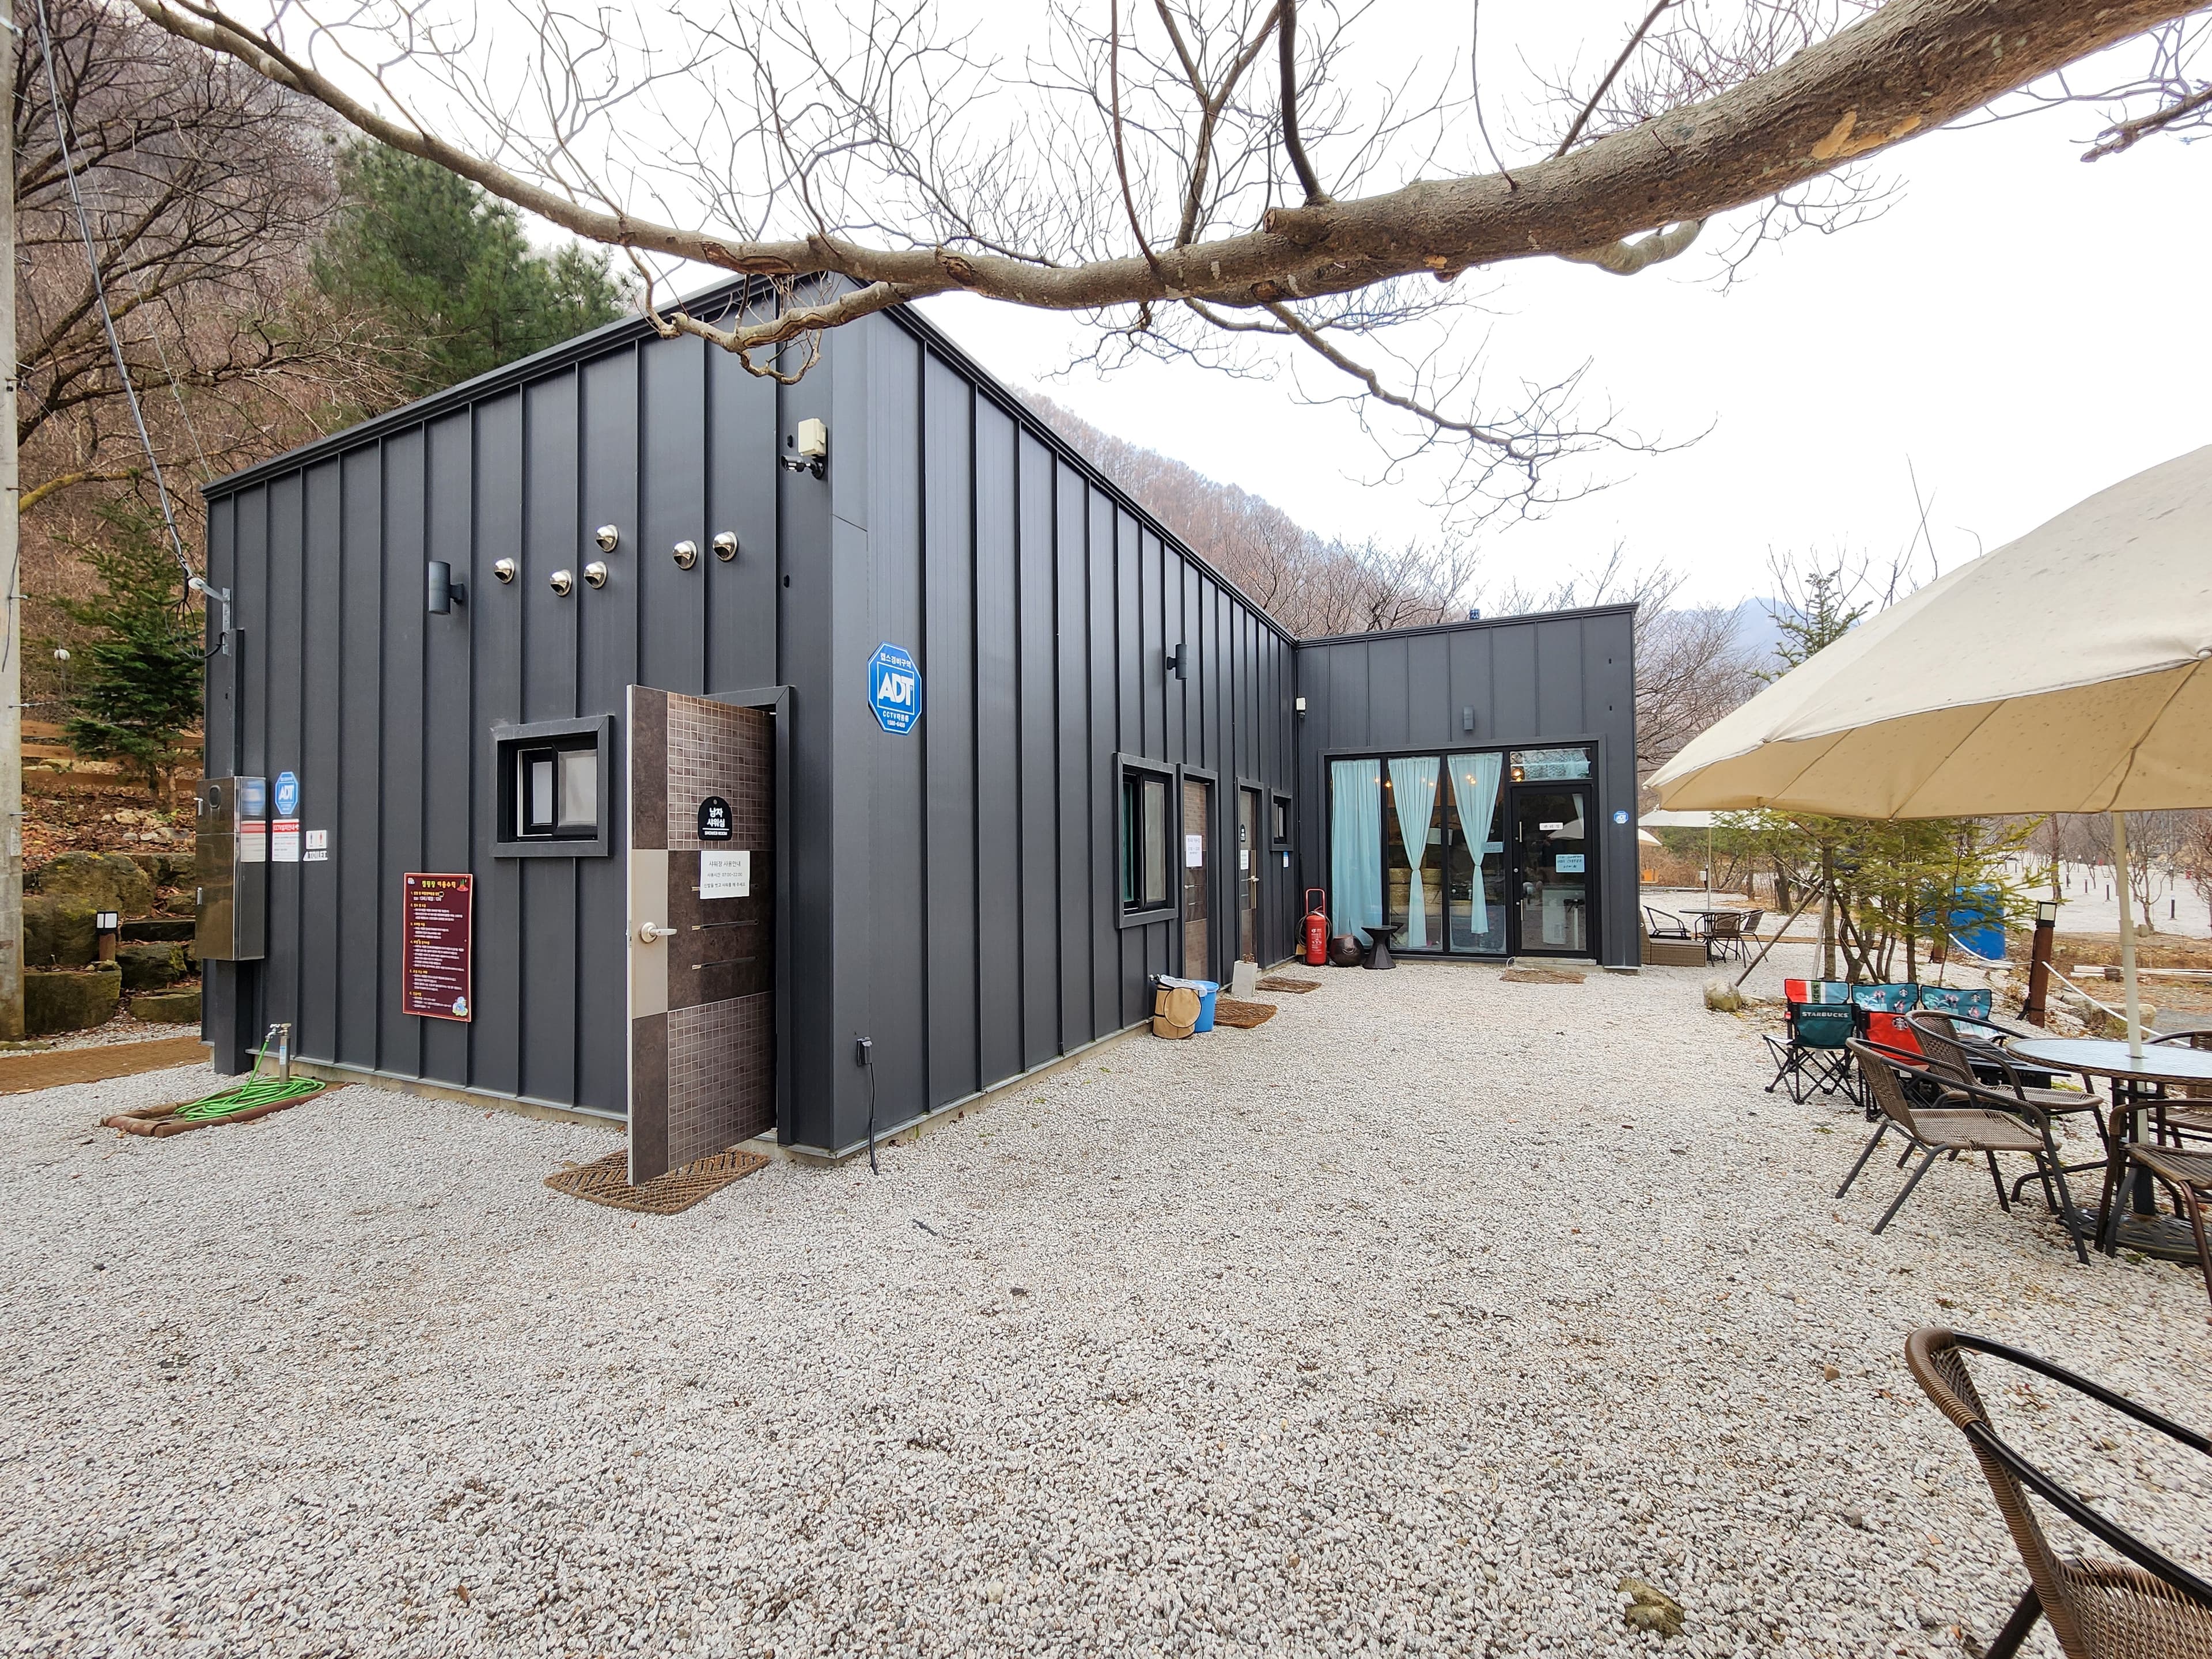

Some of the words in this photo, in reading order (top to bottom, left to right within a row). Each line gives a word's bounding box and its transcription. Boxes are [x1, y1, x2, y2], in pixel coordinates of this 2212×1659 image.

[878, 672, 913, 706] ADT
[279, 785, 294, 800] ADT
[709, 807, 724, 817] 남자
[707, 818, 725, 828] 샤워실
[309, 851, 327, 859] TOILET
